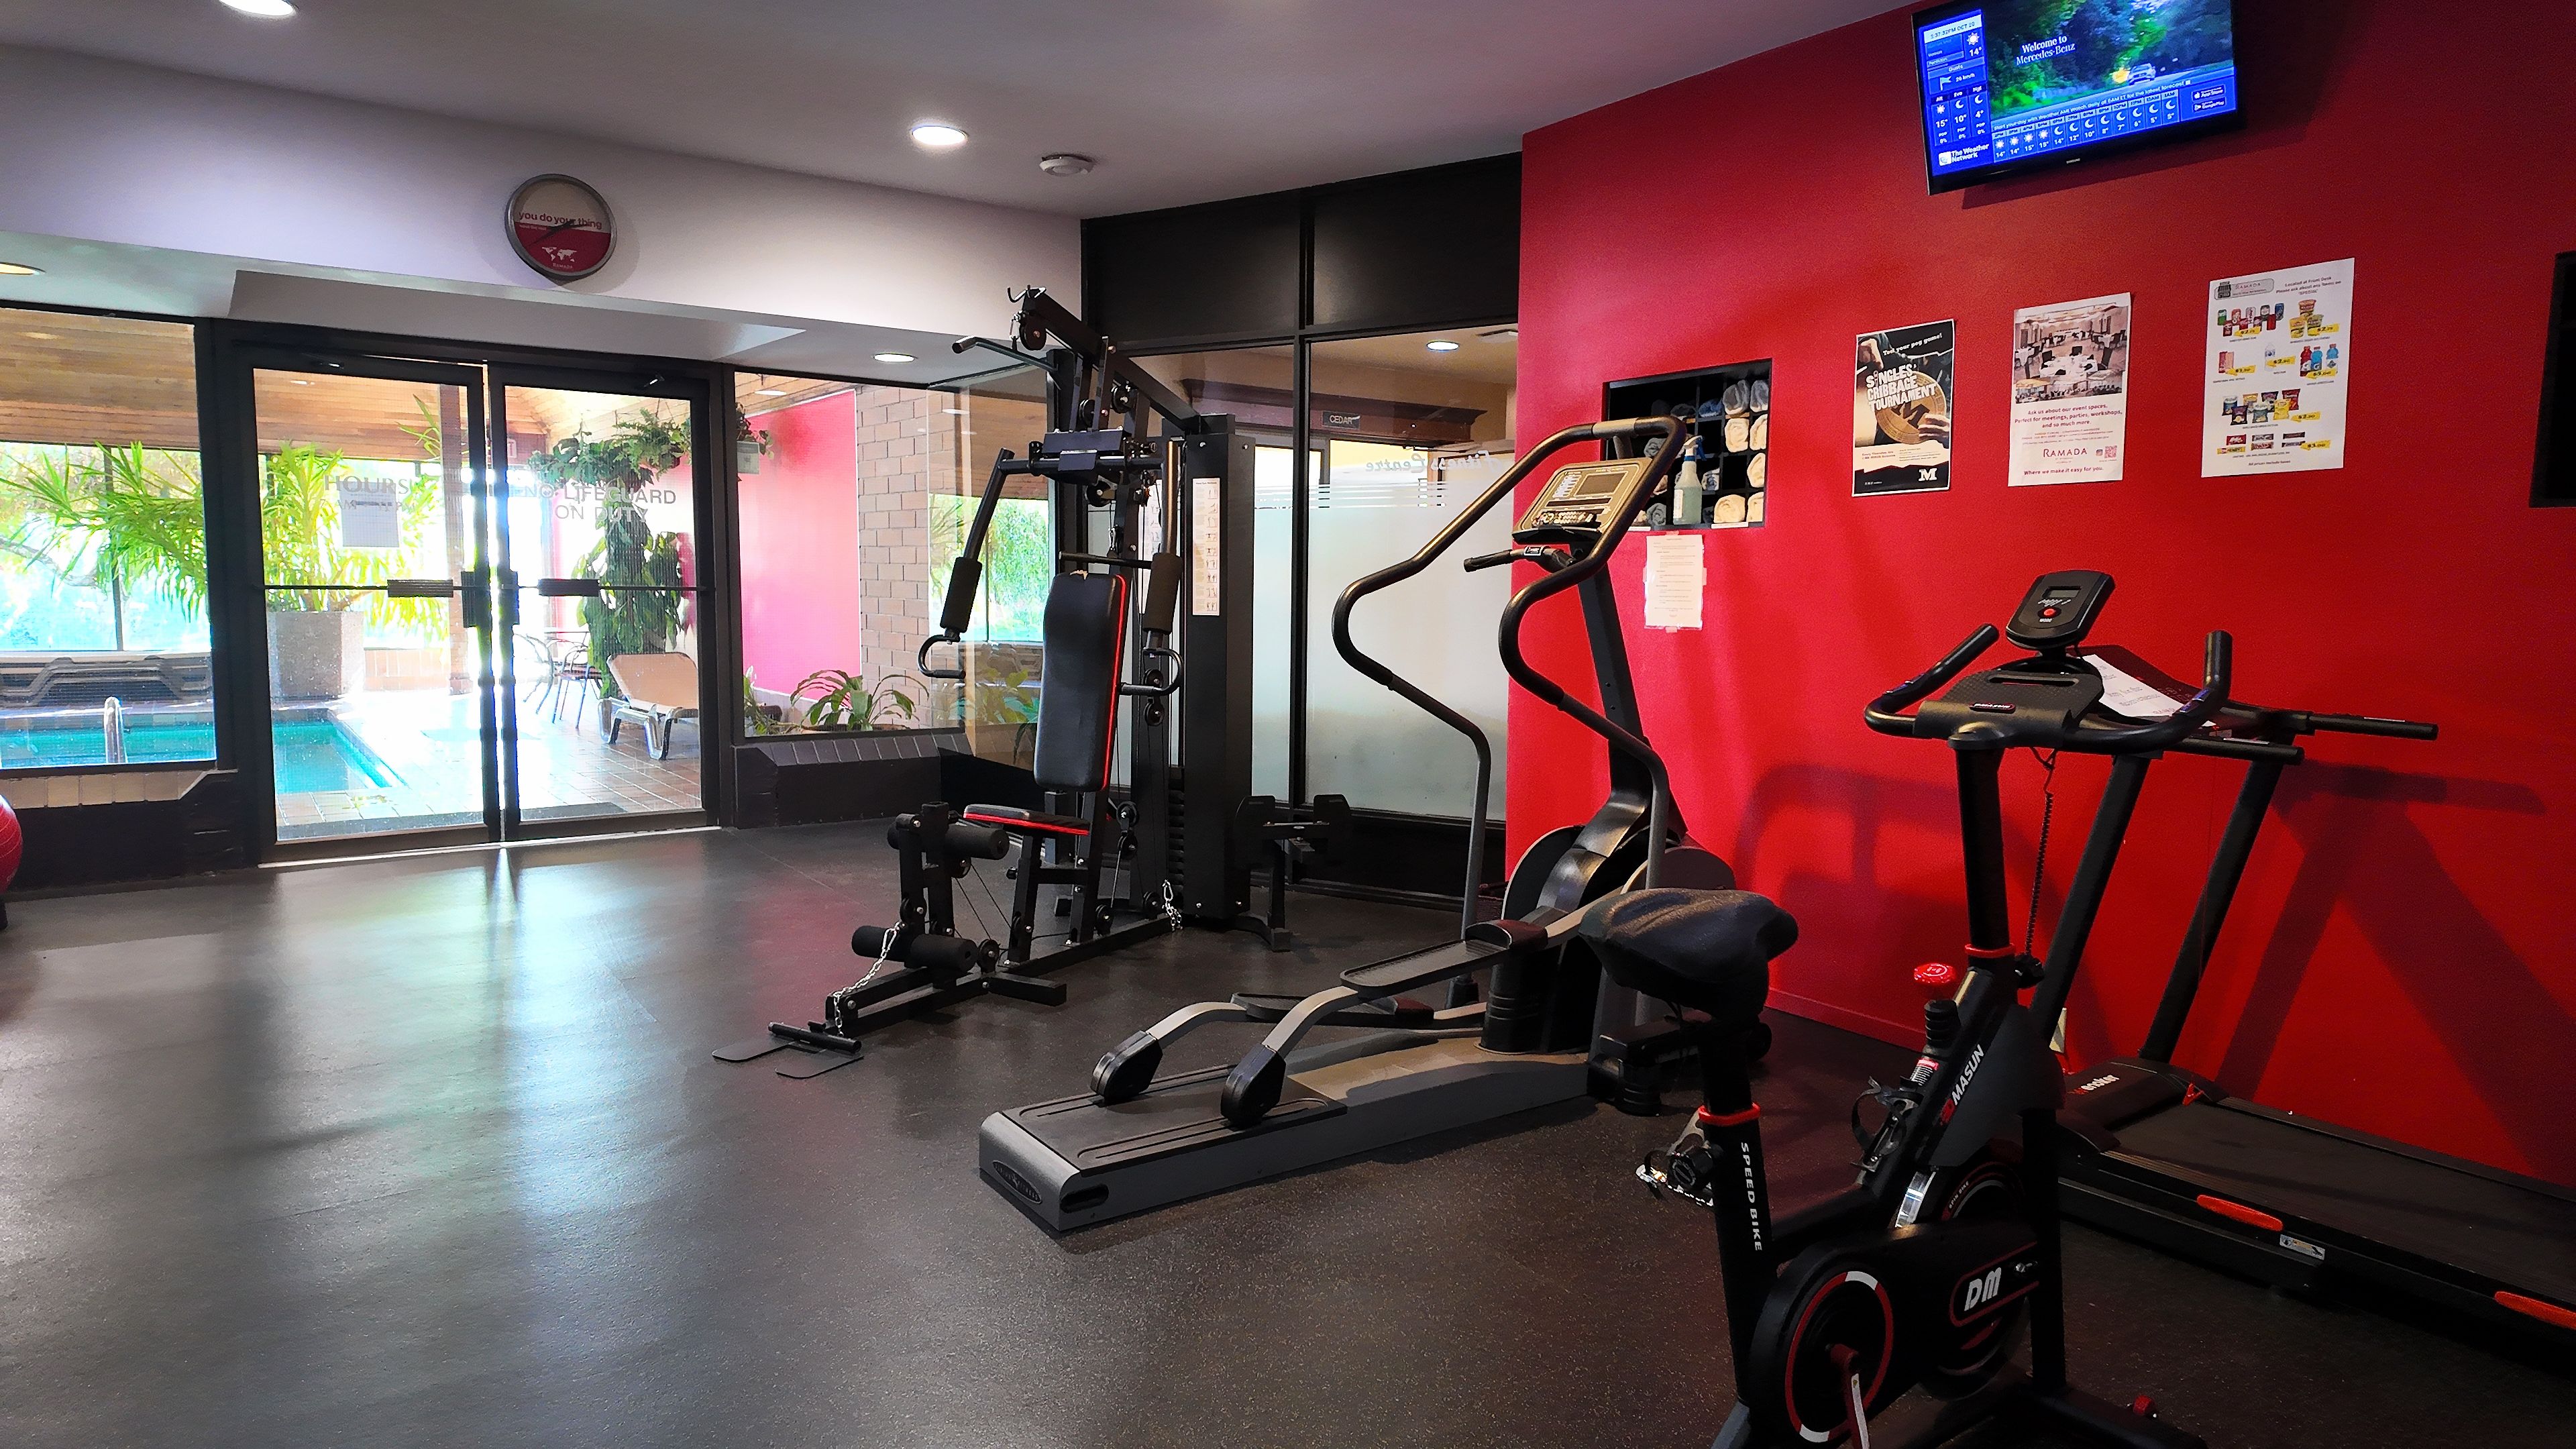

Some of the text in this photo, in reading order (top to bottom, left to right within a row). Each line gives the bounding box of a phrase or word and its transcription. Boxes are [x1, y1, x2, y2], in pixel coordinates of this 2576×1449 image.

[2022, 36, 2068, 53] Welcome to
[2016, 43, 2076, 65] Mercedes-Benz
[1951, 152, 1978, 162] Network
[1963, 144, 1990, 154] Weather
[519, 211, 537, 221] you
[539, 213, 553, 223] do
[1896, 344, 1910, 352] your
[1867, 375, 1919, 401] CRIBBAGE
[1869, 383, 1937, 412] TOURNAMENT
[1329, 415, 1353, 425] CEDAR
[2041, 413, 2069, 421] meetings,
[2090, 409, 2123, 417] workshops,
[2043, 447, 2088, 458] RAMADA
[1919, 468, 1937, 482] M
[324, 474, 410, 494] HOURS
[525, 483, 676, 504] NO LIFEGUARD
[555, 504, 649, 523] ON DUTY
[1741, 1142, 1762, 1251] SPEED BIKE
[1964, 1267, 2002, 1311] DM
